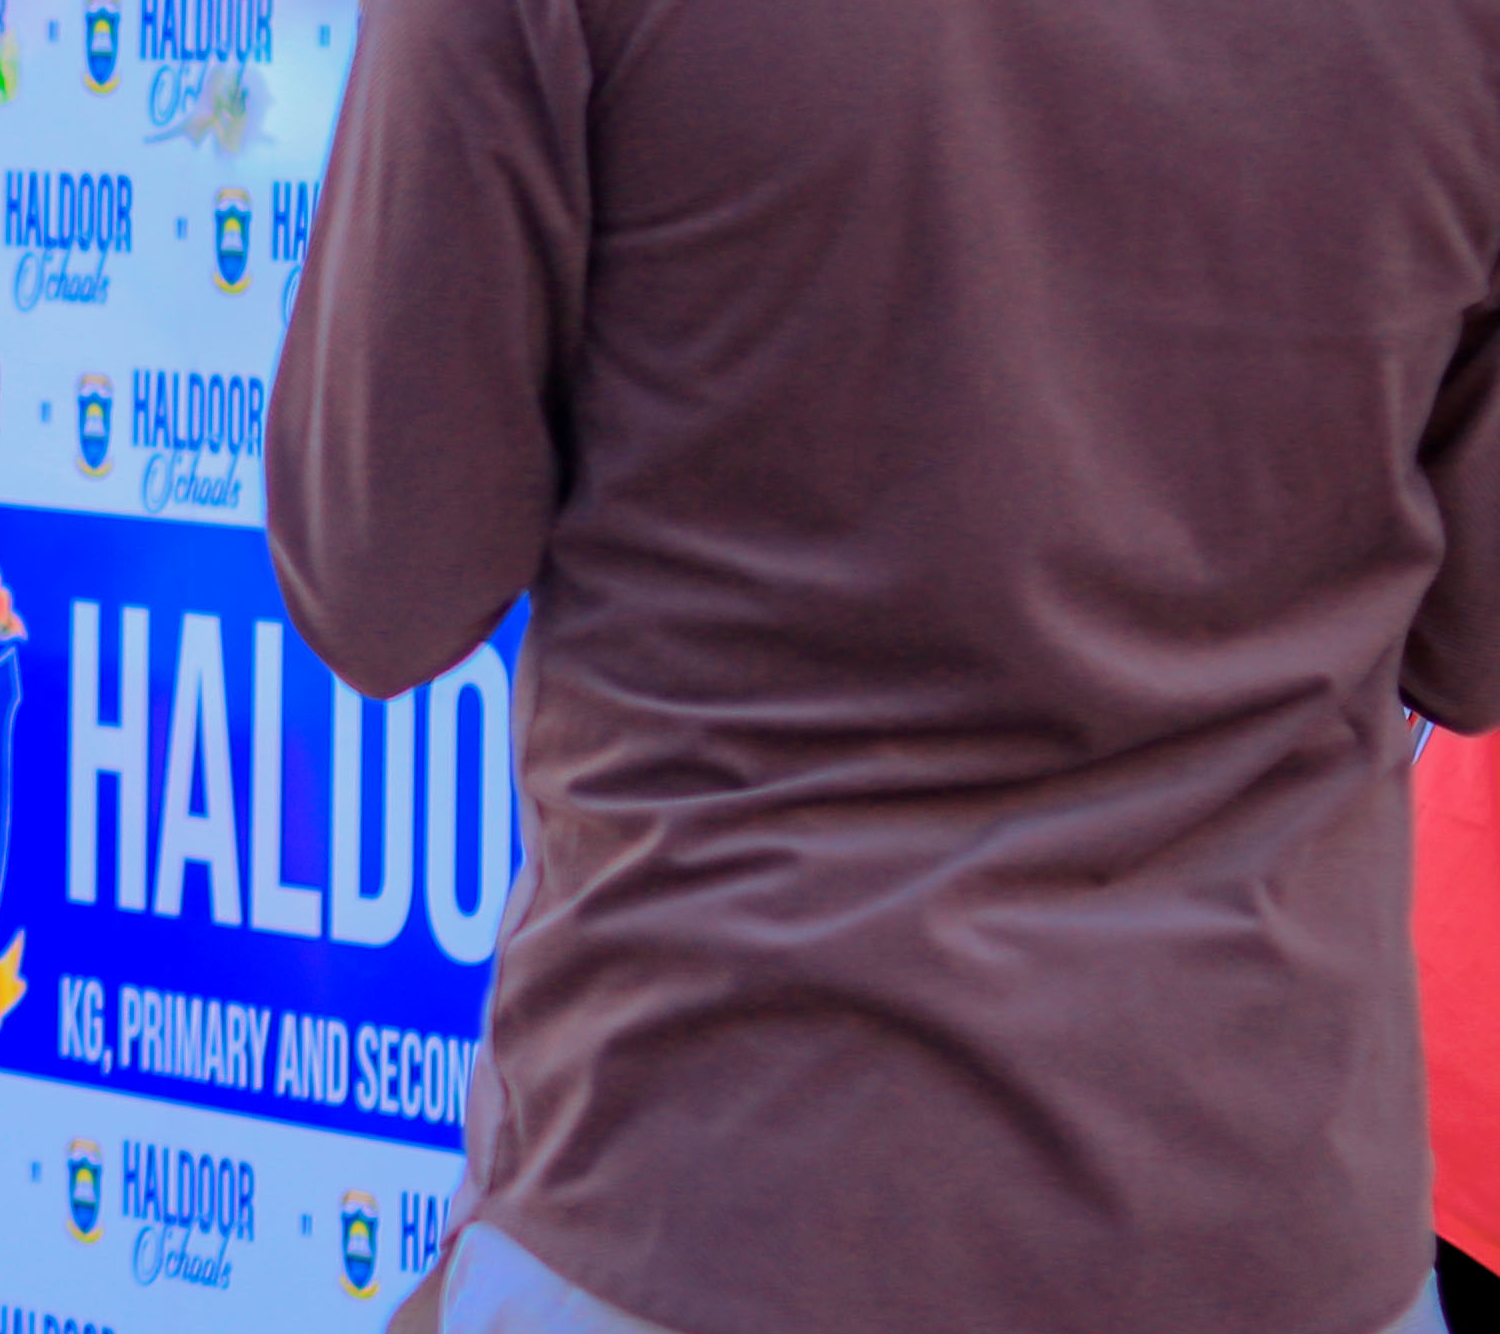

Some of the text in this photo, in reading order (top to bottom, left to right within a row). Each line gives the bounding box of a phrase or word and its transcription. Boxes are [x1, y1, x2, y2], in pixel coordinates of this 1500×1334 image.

[5, 170, 132, 253] HALDOOR
[132, 369, 265, 456] HALDOOR
[142, 450, 242, 514] Schools
[66, 599, 512, 965] HALDO
[59, 974, 480, 1128] KG, PRIMARY AND SECON
[121, 1139, 255, 1243] HALDOOR
[132, 1222, 232, 1291] Schools
